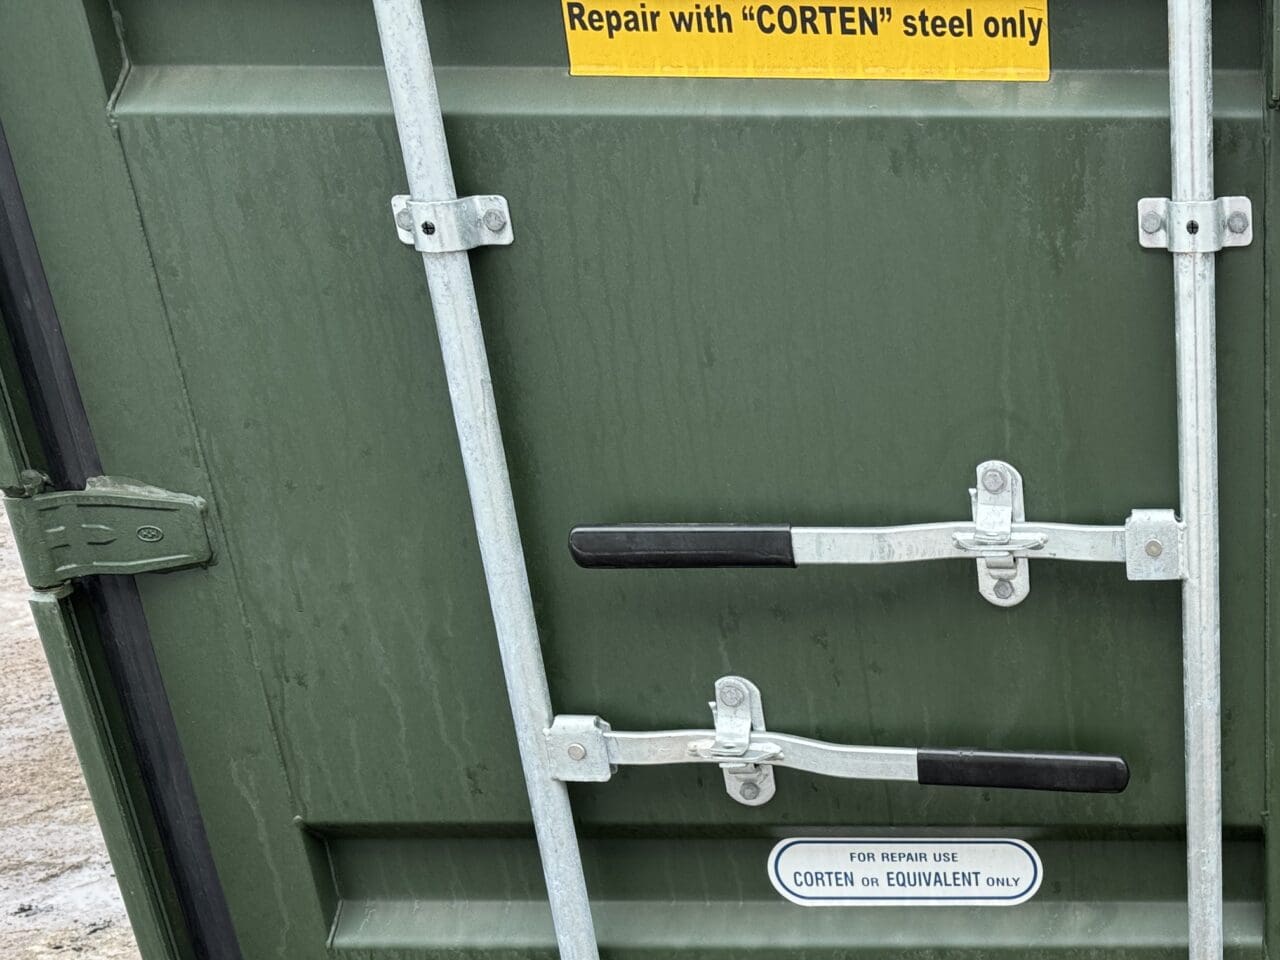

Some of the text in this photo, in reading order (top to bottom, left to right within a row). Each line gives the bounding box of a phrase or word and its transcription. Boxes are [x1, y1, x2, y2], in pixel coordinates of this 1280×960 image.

[566, 1, 1043, 46] Repair with “CORTEN” steel only
[849, 852, 959, 863] FOR REPAIR USE
[793, 871, 1021, 888] CORTEN OR EQUIVALENT ONLY
